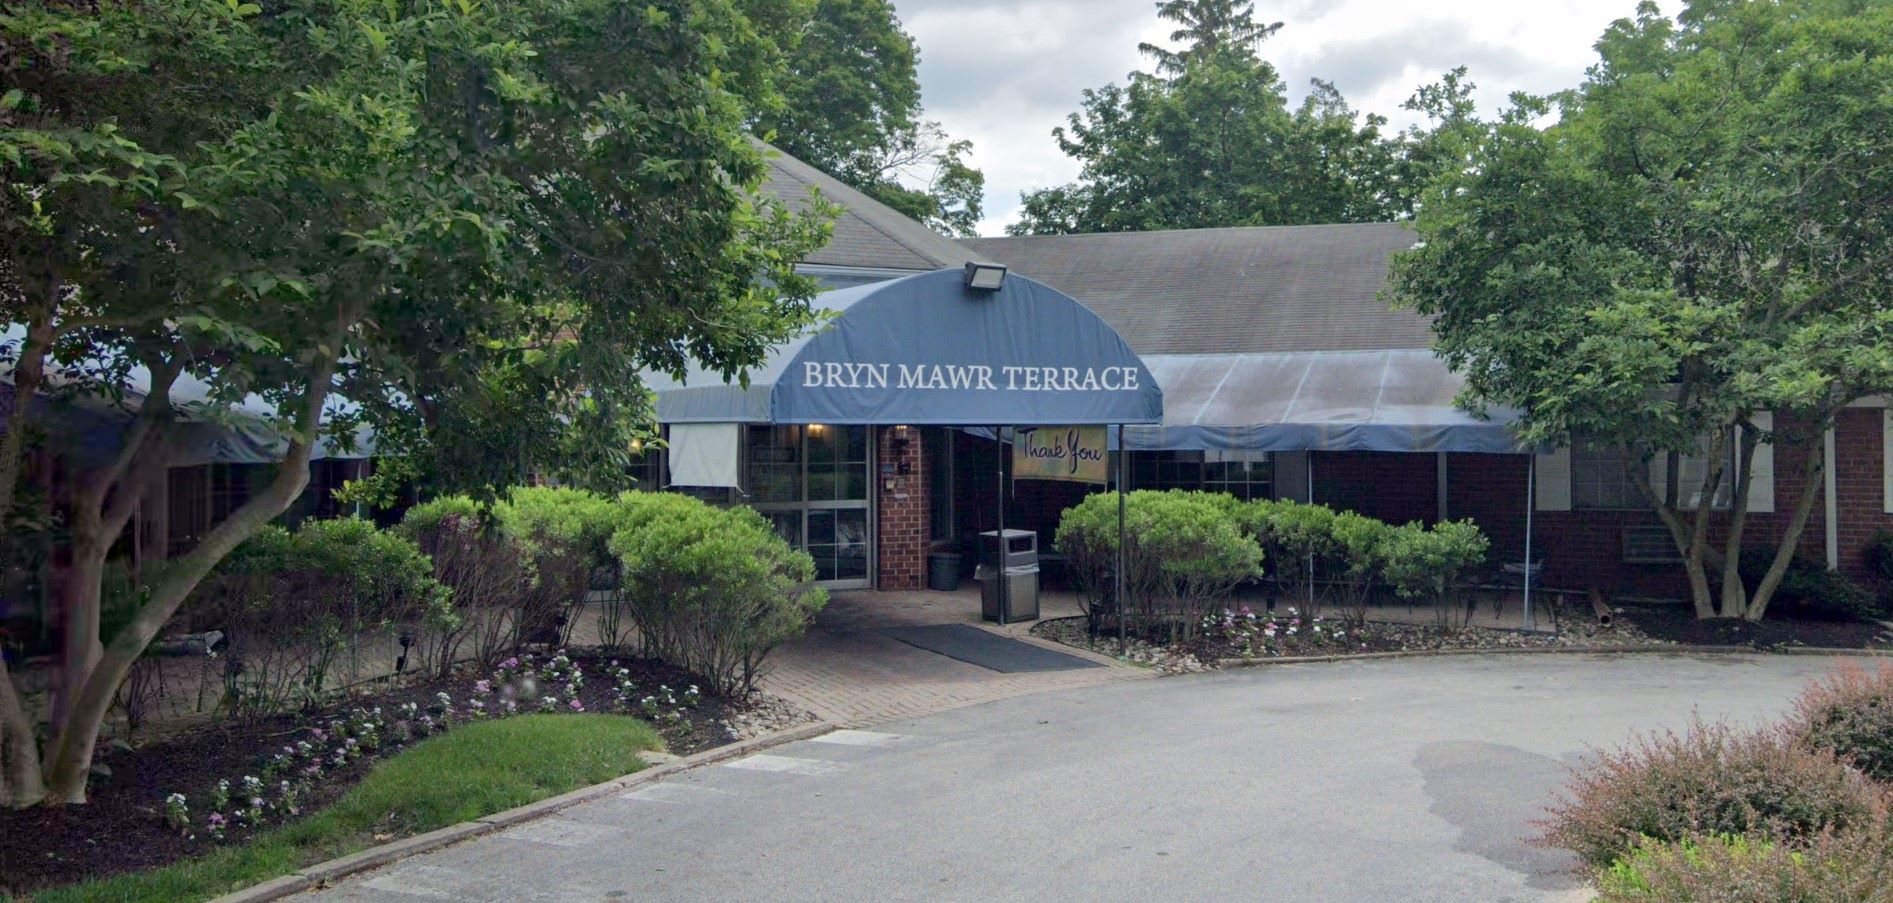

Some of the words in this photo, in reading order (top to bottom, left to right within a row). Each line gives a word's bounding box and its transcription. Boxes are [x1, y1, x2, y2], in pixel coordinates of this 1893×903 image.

[802, 361, 890, 388] BRYN
[896, 364, 997, 390] MAWR
[1002, 366, 1139, 391] TERRACE
[1017, 427, 1067, 458] Thank
[1067, 428, 1102, 474] You
